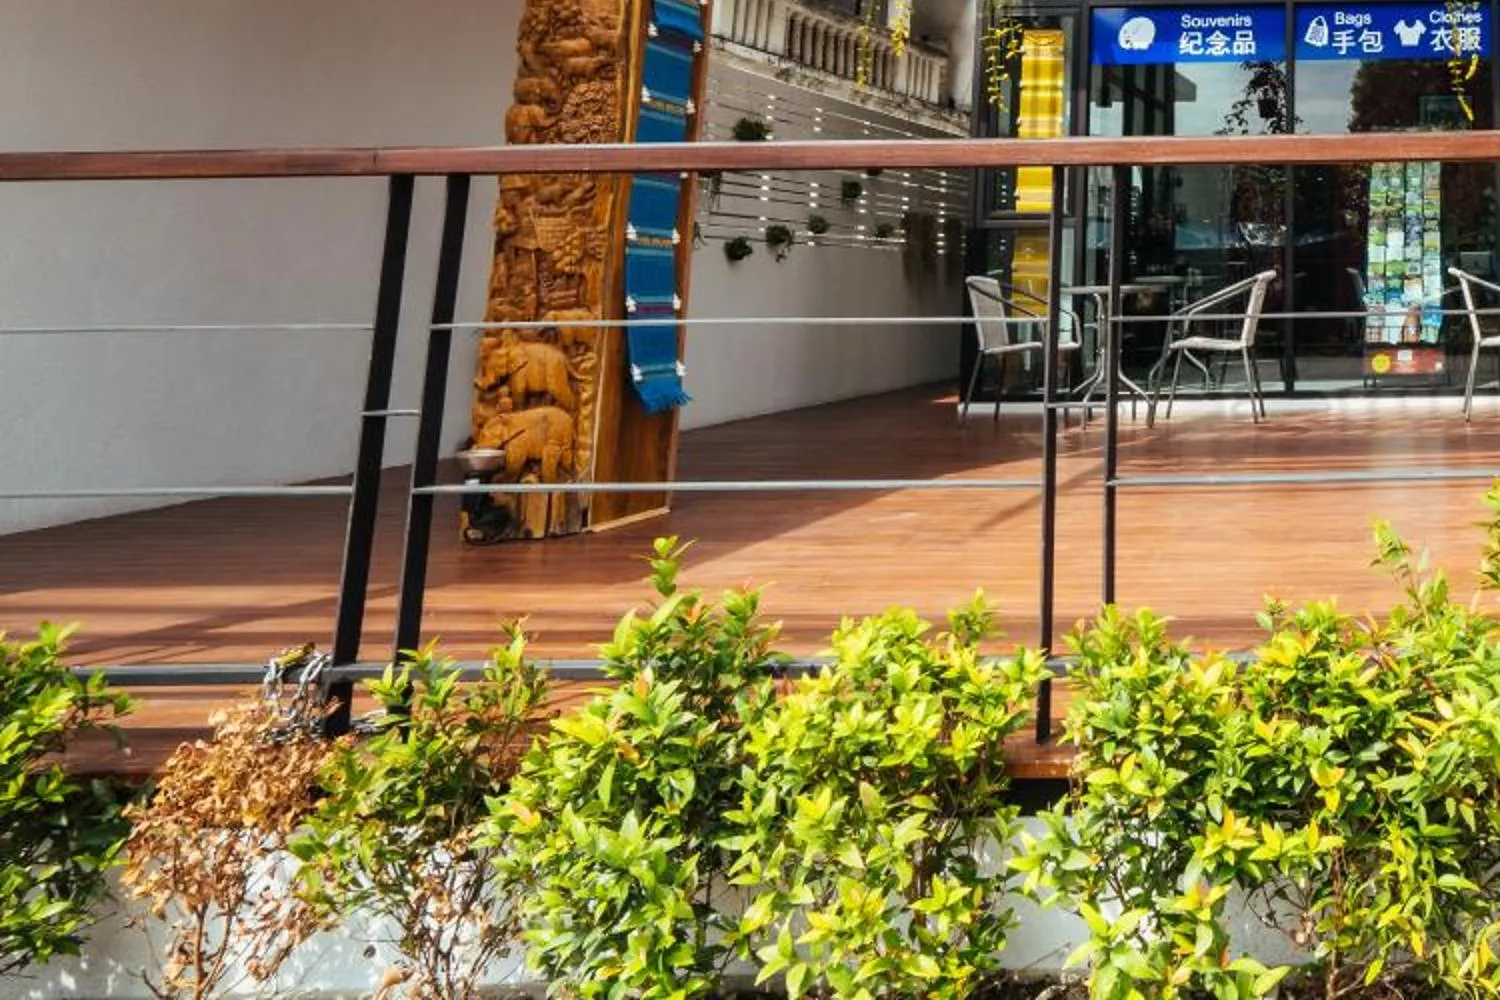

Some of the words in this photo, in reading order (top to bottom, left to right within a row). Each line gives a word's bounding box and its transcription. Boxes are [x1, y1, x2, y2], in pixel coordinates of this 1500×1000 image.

[1181, 14, 1252, 28] Souvenirs
[1334, 11, 1372, 27] Bags
[1179, 31, 1257, 55] 纪念品
[1332, 30, 1384, 55] 手包
[1430, 27, 1482, 52] 衣服
